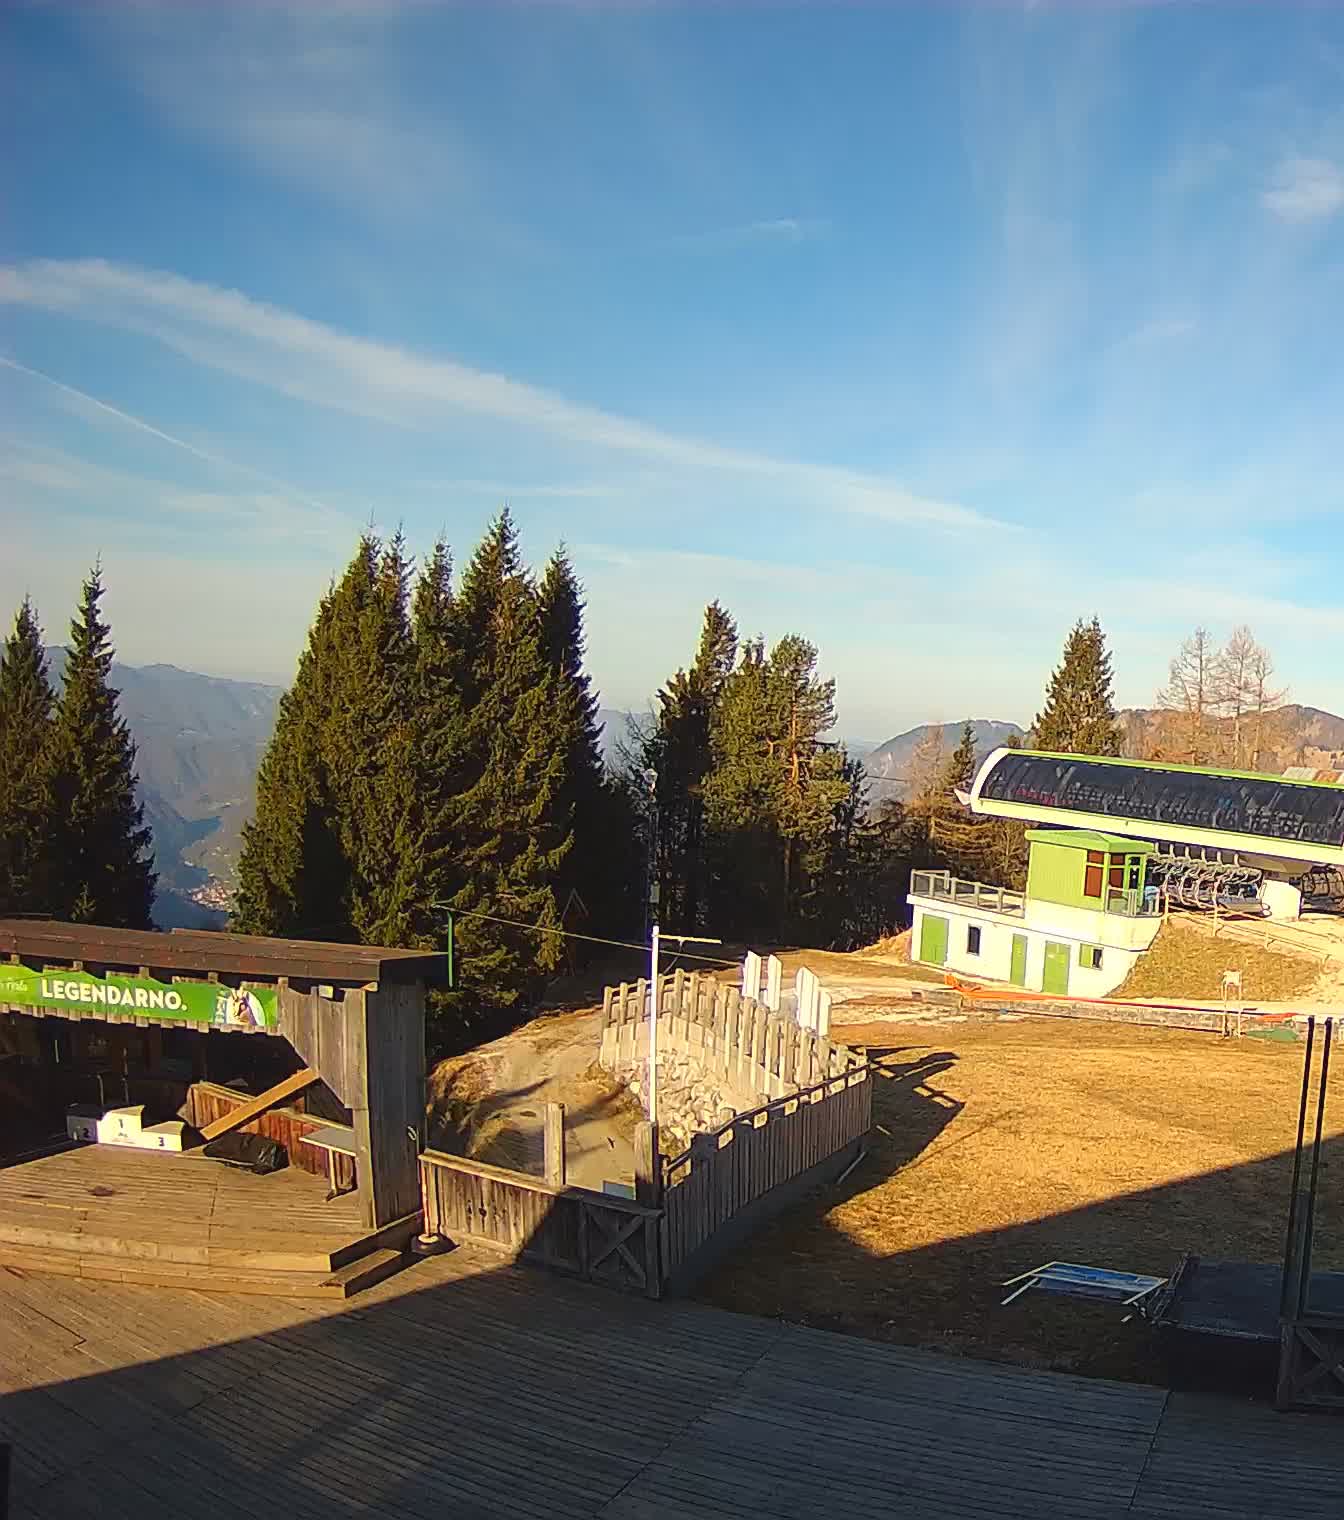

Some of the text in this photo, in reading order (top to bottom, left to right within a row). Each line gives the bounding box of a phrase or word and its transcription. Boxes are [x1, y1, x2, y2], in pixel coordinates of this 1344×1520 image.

[41, 977, 188, 1011] LEGENDARNO.
[117, 1118, 124, 1129] 1
[82, 1127, 90, 1138] 2
[157, 1136, 165, 1147] 3
